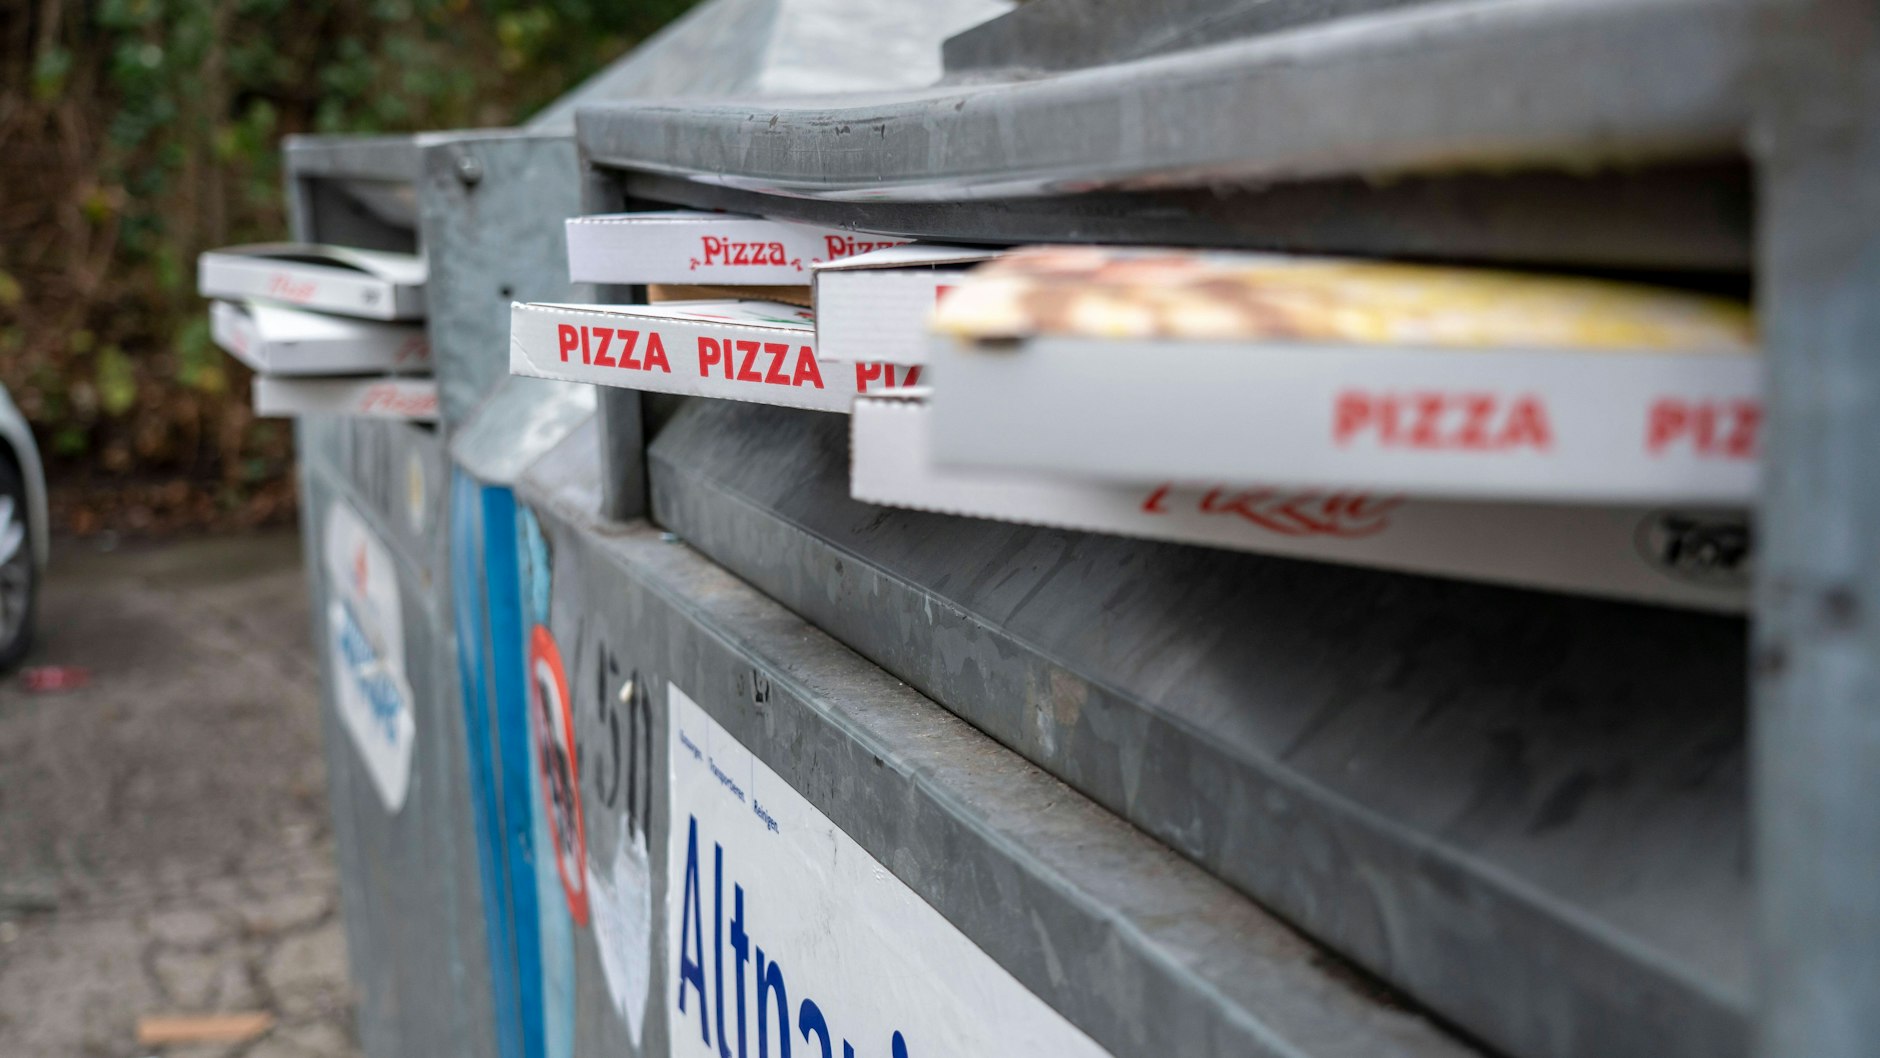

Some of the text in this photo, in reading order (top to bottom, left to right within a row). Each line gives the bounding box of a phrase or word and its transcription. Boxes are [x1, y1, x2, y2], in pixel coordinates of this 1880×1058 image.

[700, 235, 909, 266] Pizza Piz
[557, 323, 924, 394] PIZZA PIZZA PIZ
[1332, 390, 1760, 461] PIZZA PIZ
